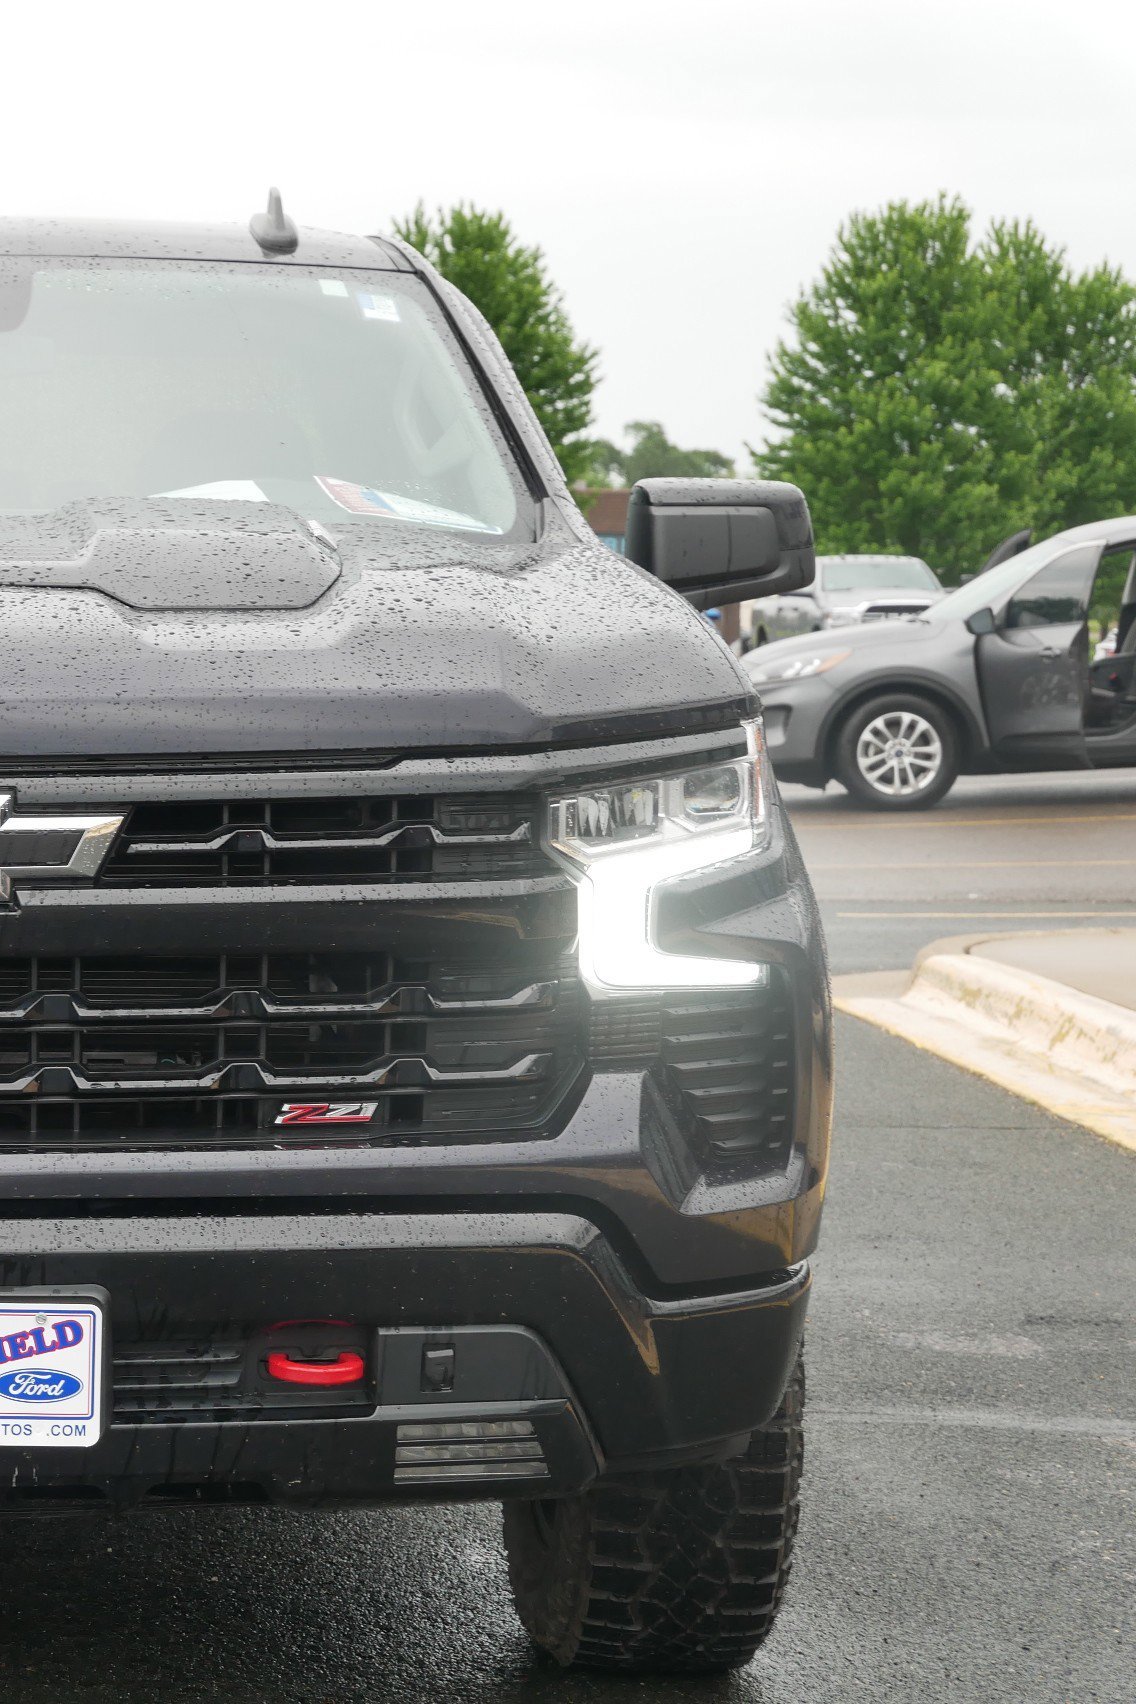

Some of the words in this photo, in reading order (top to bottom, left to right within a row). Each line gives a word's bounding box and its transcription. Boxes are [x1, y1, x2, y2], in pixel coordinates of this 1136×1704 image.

[274, 1102, 379, 1125] Z71
[9, 1373, 64, 1399] Ford
[46, 1424, 87, 1437] .COM
